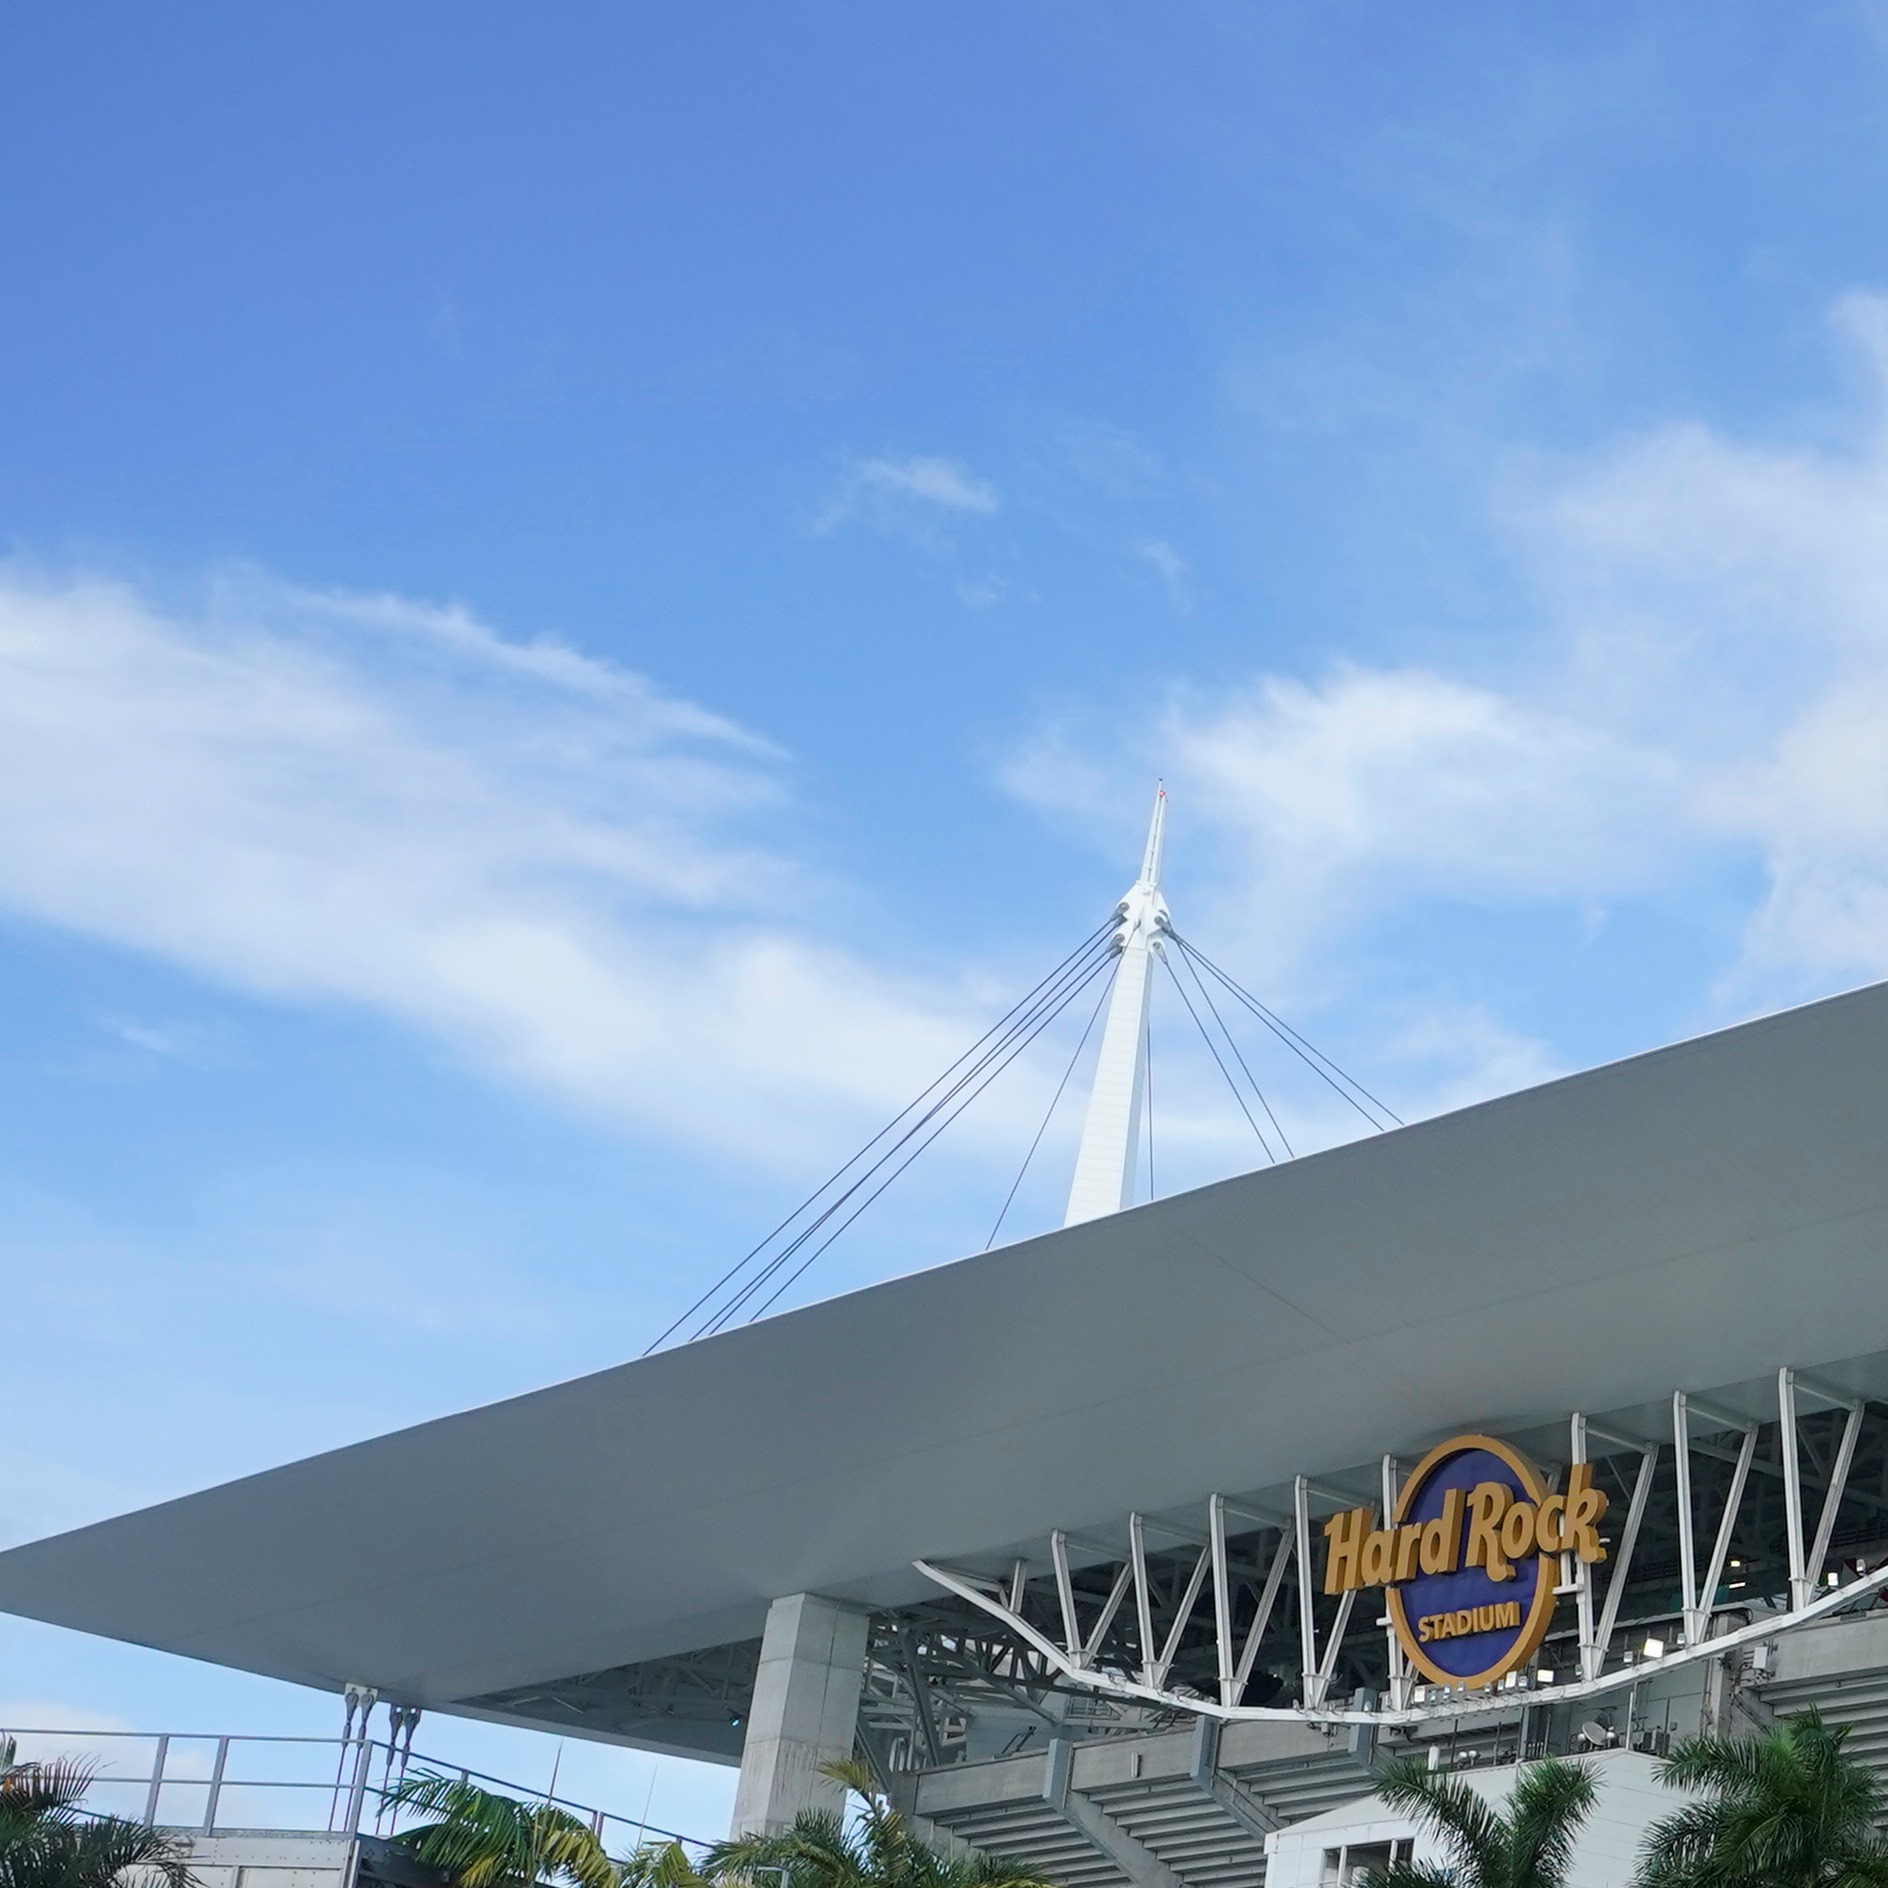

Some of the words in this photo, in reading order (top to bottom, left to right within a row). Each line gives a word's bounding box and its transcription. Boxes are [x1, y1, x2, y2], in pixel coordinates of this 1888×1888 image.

[1324, 1488, 1466, 1596] Hard
[1466, 1463, 1608, 1583] Rock
[1417, 1601, 1521, 1643] STADIUM
